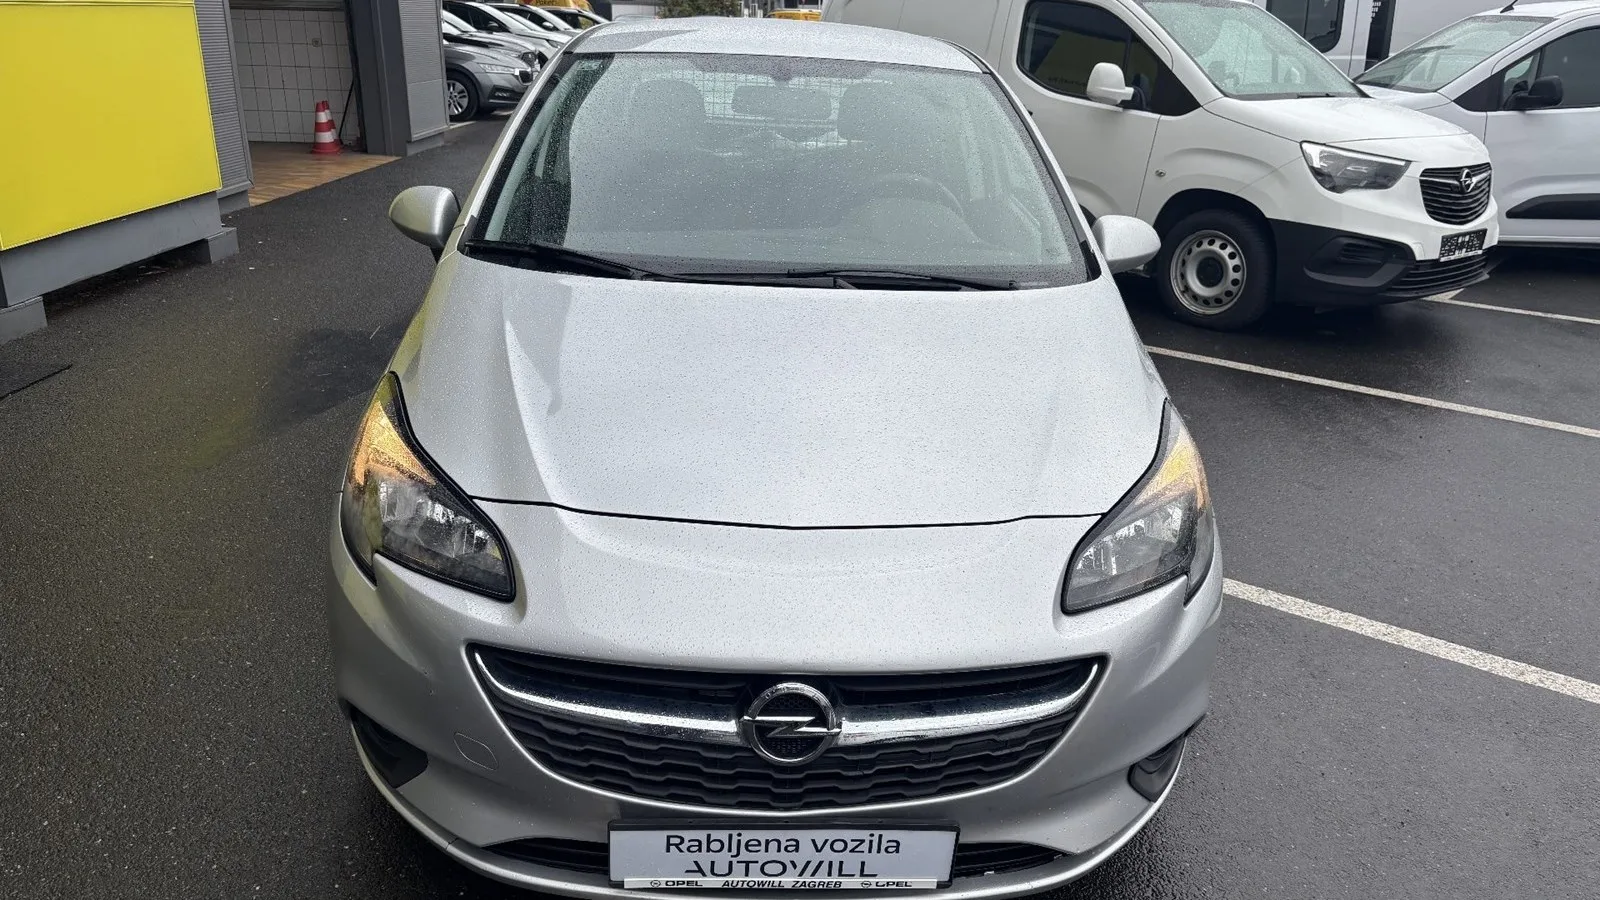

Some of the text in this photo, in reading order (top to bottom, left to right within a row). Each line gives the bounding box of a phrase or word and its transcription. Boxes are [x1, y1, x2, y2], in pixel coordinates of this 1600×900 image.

[665, 832, 901, 858] Rabljena vozila
[684, 860, 878, 877] AUTOWILL
[721, 880, 785, 888] AUTOWILL
